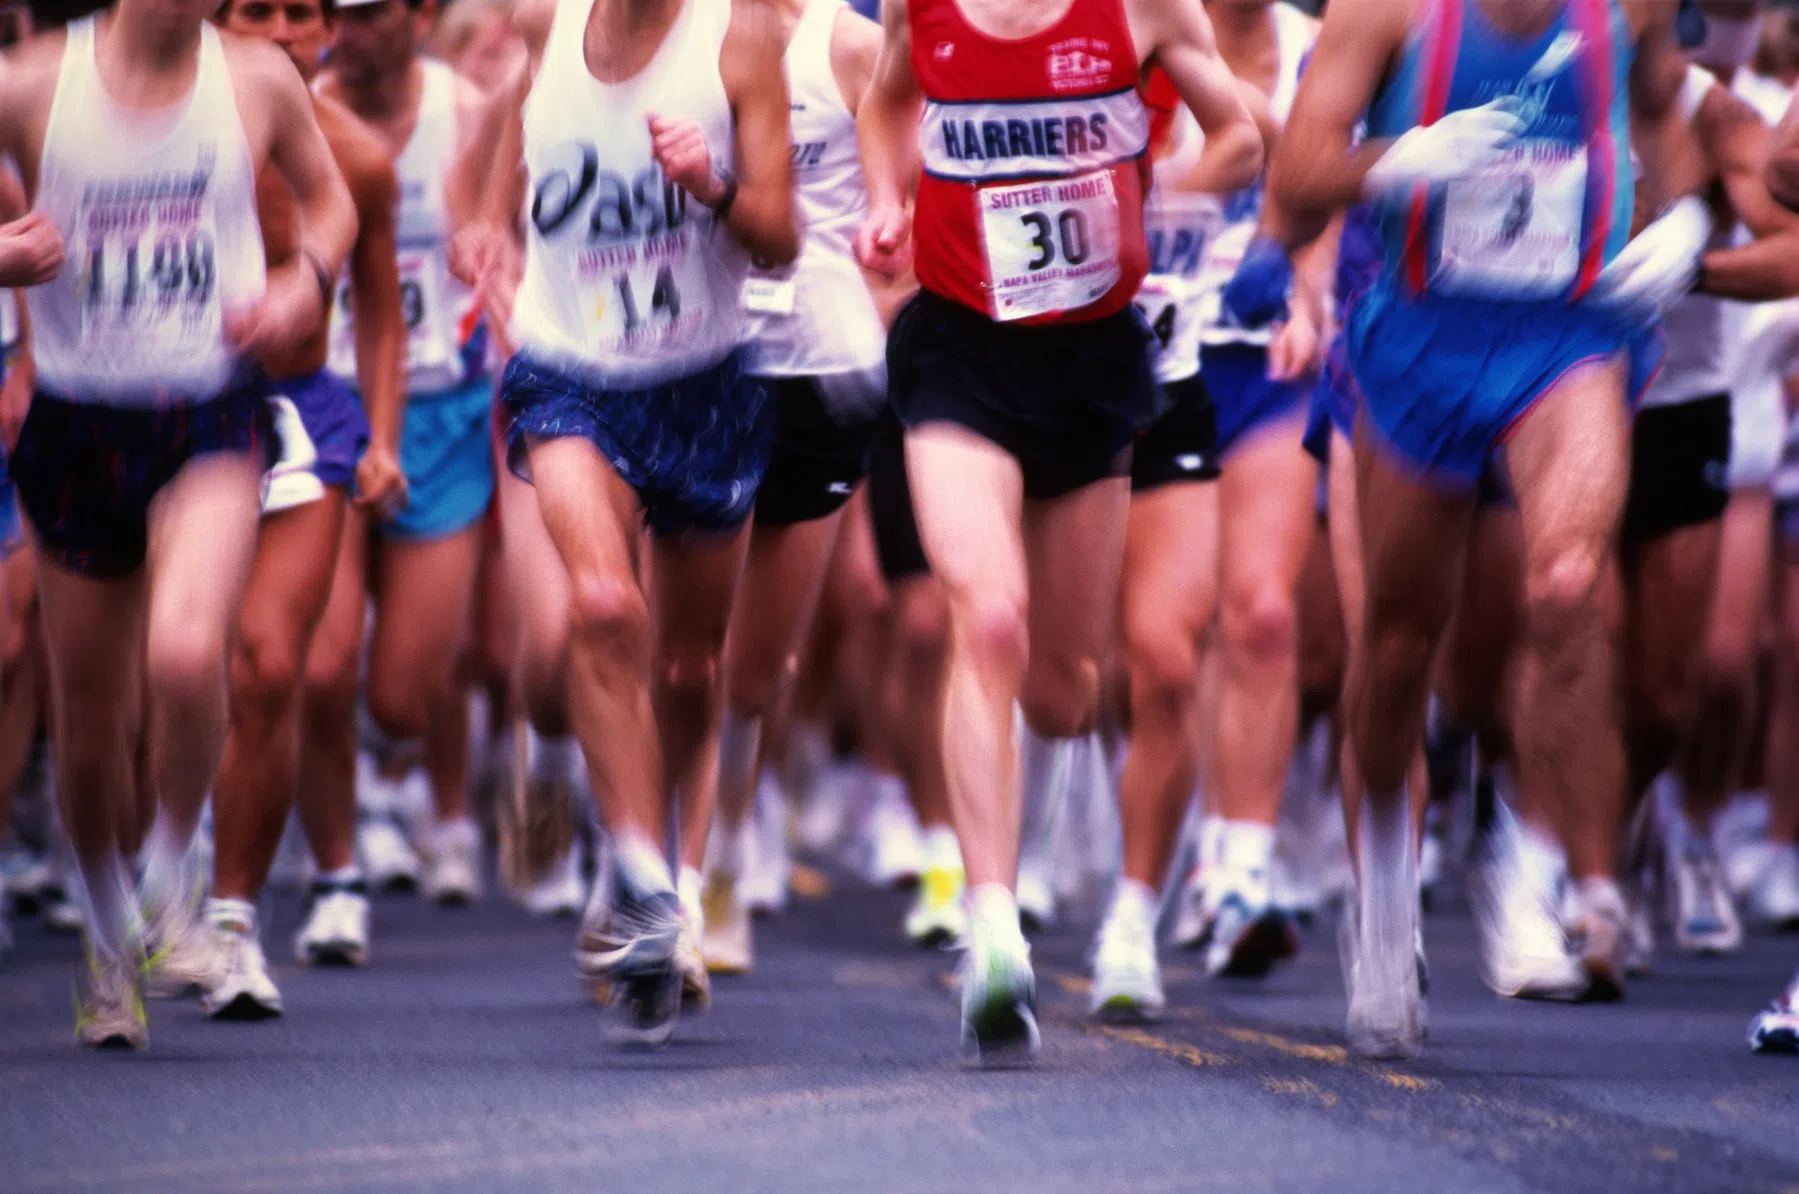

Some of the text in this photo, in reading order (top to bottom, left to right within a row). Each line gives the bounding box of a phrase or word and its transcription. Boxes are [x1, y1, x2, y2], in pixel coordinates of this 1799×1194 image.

[942, 112, 1108, 160] HARRIERS
[991, 179, 1106, 209] SUTTER HOME
[1021, 208, 1090, 271] 30
[1003, 275, 1029, 288] NAPA
[1032, 267, 1063, 283] VALLEY
